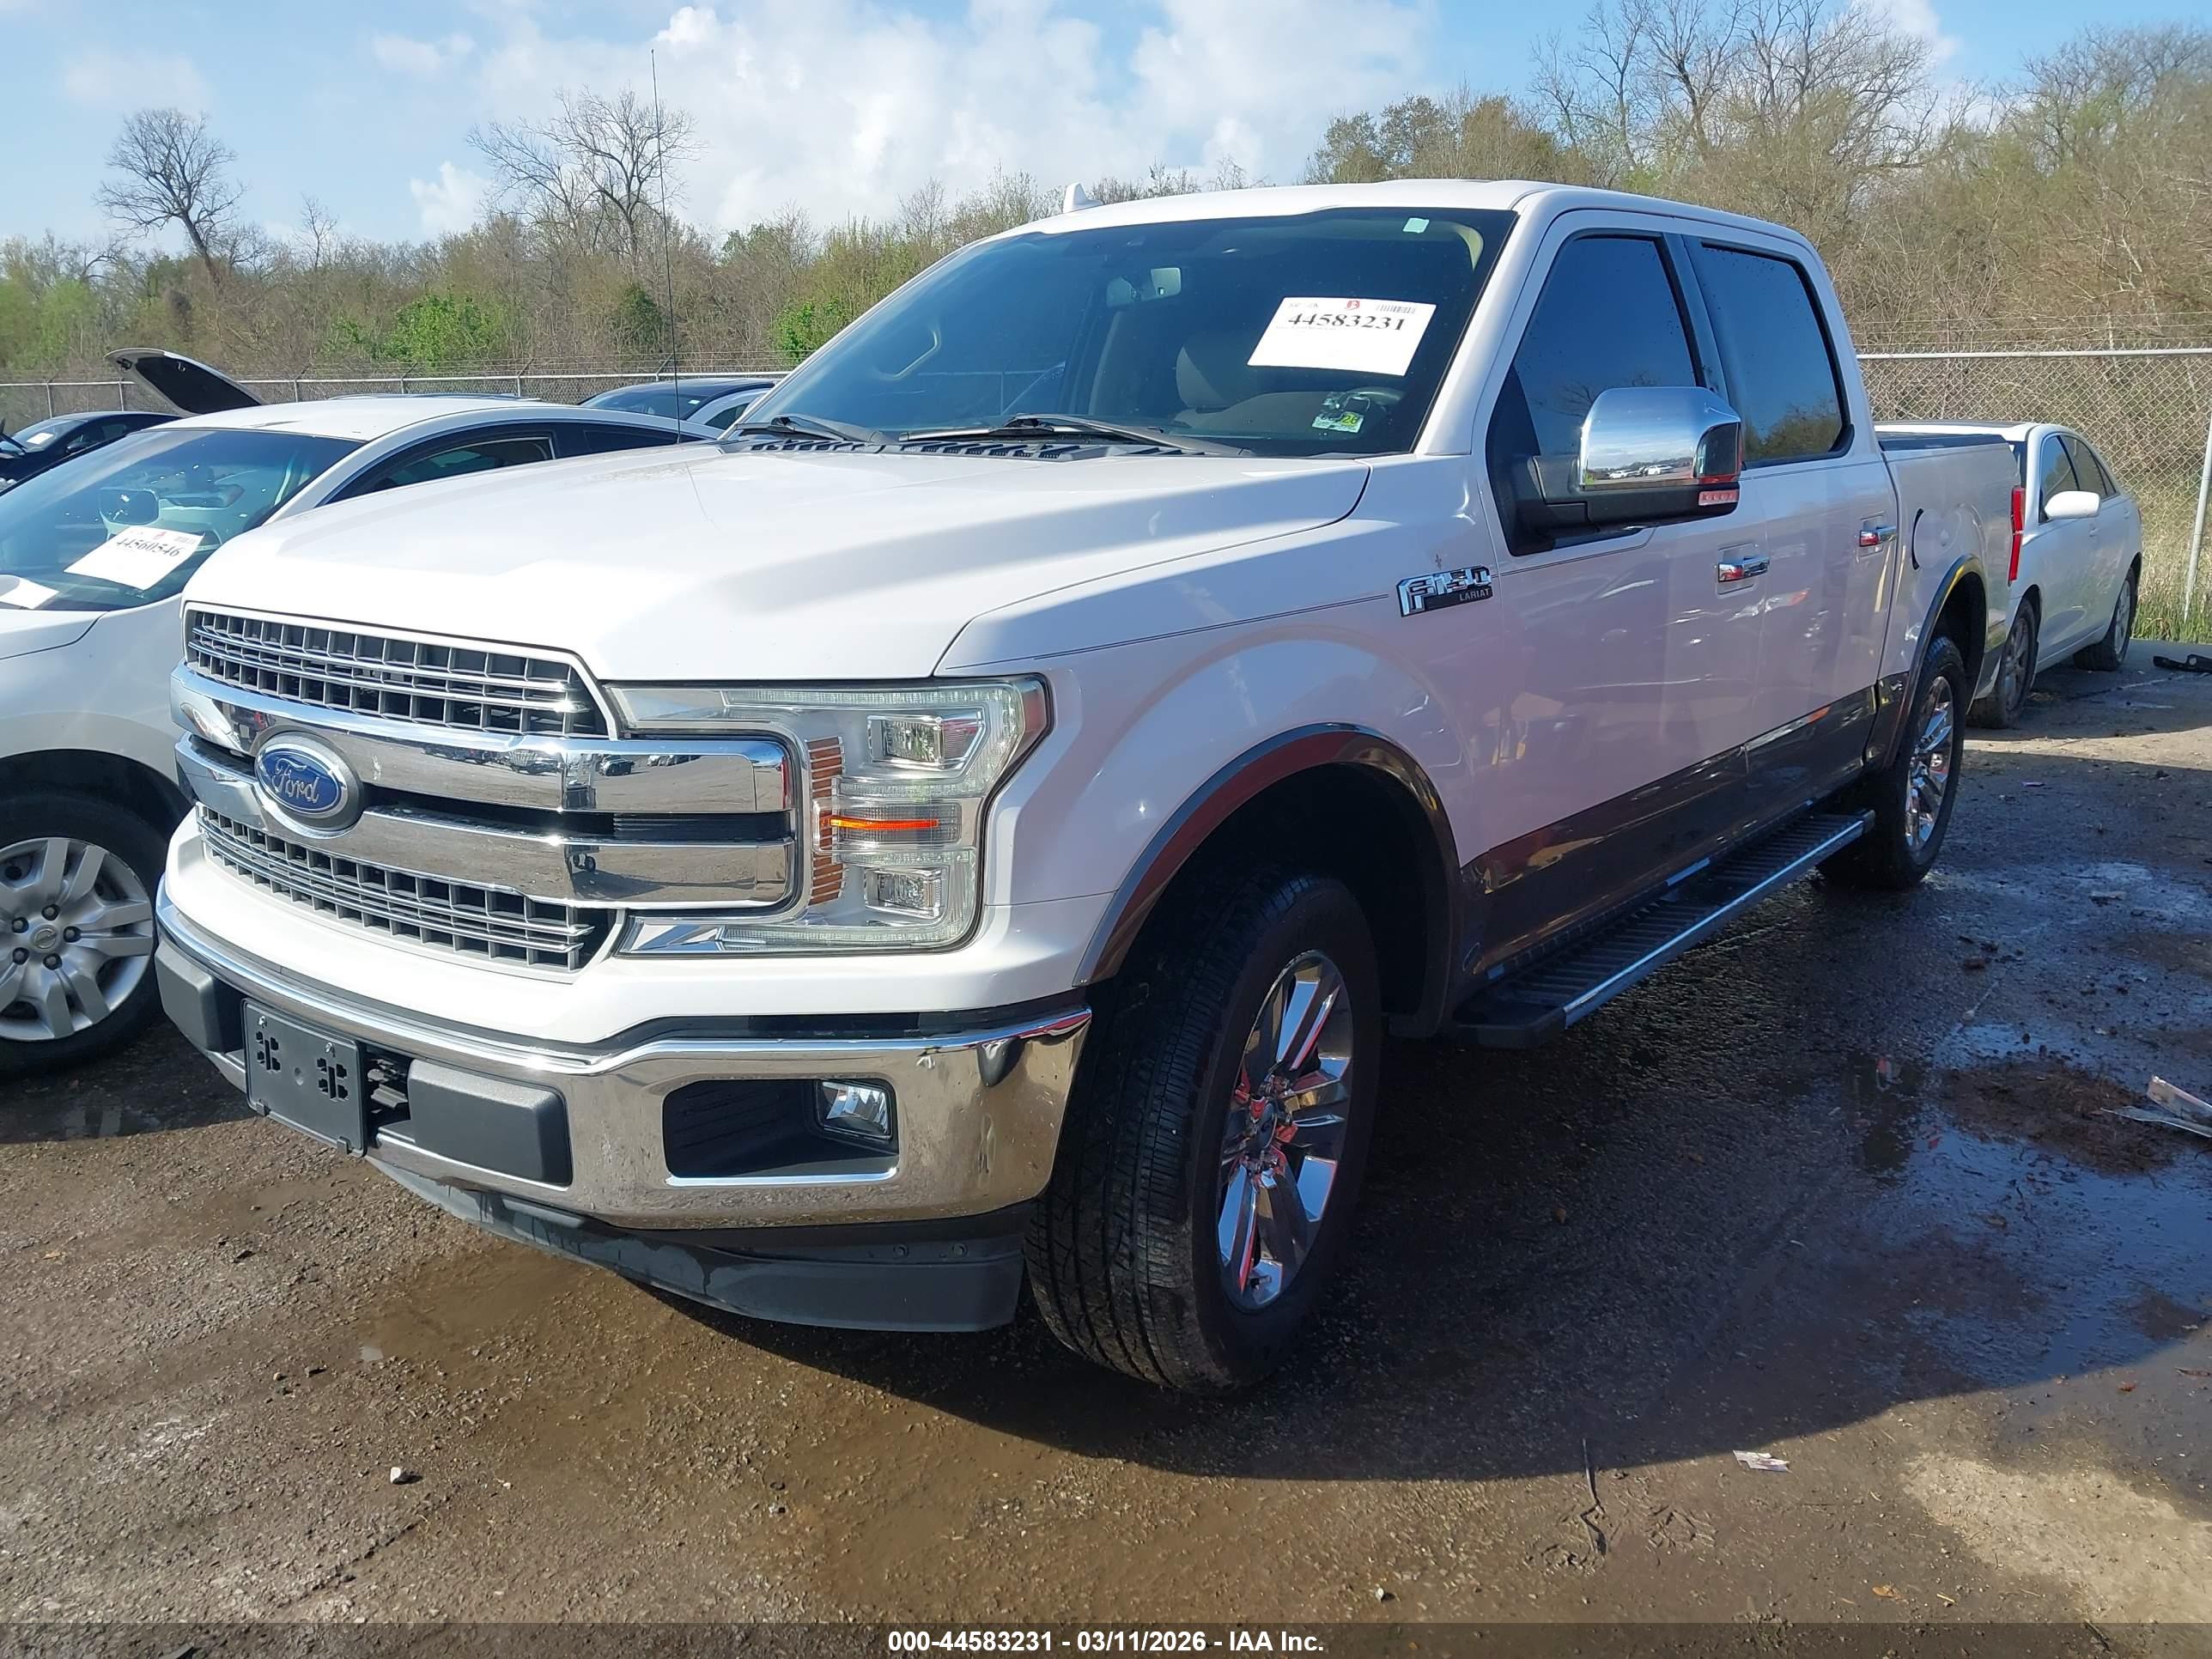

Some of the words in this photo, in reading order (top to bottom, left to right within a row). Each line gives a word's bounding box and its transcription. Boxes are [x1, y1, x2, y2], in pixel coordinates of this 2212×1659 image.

[1288, 313, 1406, 331] 44583231
[118, 538, 182, 557] 44560546
[1459, 588, 1490, 602] LARIAT
[272, 757, 320, 804] Ford
